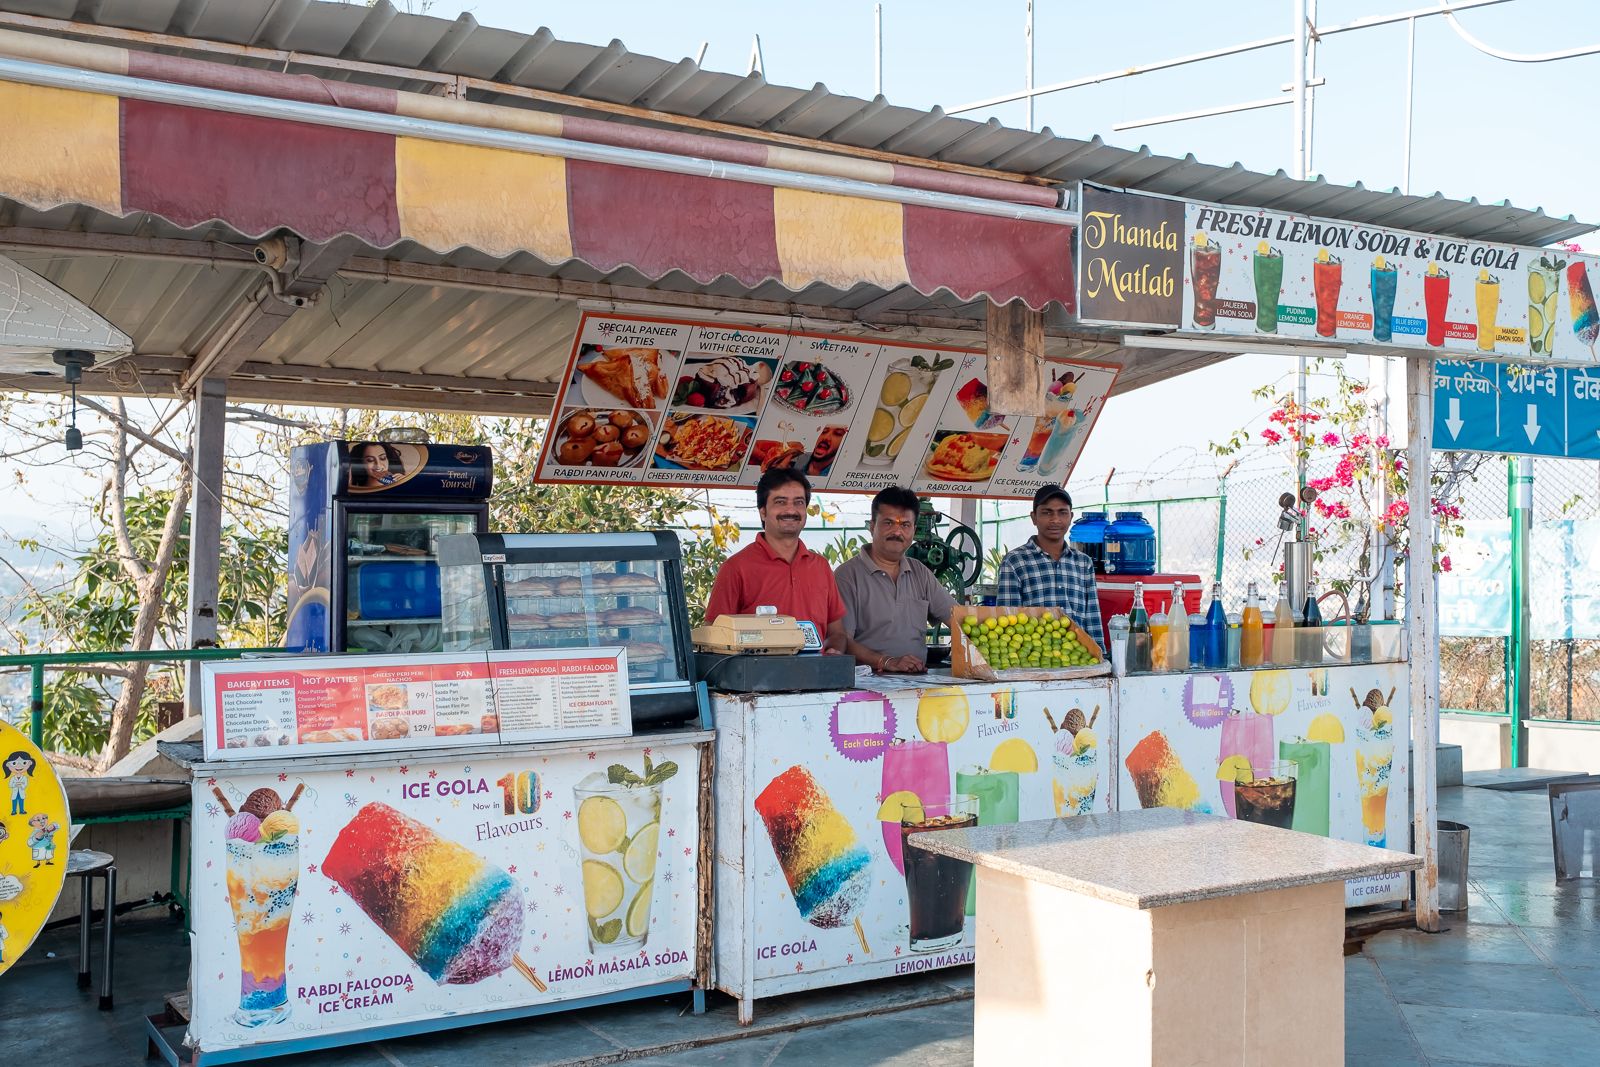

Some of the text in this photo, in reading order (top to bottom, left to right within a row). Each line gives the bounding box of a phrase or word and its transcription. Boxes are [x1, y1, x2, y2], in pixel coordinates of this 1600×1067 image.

[1084, 211, 1178, 251] Thanda
[1196, 208, 1519, 270] FRESH LEMON SODA & ICE GOLA
[1087, 258, 1174, 302] Matlab
[1222, 301, 1248, 310] JALJEERA
[1286, 307, 1307, 315] PUDINA
[1216, 308, 1253, 319] LEMON SODA
[1278, 314, 1314, 324] LEMON SODA
[1343, 312, 1365, 321] ORANGE
[597, 322, 678, 337] SPECIAL PANEER
[1337, 320, 1370, 329] LEMON SODA
[1393, 325, 1424, 334] LEMON SODA
[1452, 323, 1468, 331] GUAVA
[699, 330, 780, 346] HOT CHOCO LAVA
[1445, 330, 1475, 339] LEMON SODA
[614, 335, 655, 346] PATTIES
[699, 341, 775, 356] WITH ICE CREAM
[809, 341, 859, 354] SWEET PAN
[1454, 371, 1490, 395] एरिया
[447, 470, 468, 479] Treat
[553, 468, 632, 479] RABDI PANI PURI
[647, 471, 737, 482] CHEESY PERI PERI NACHOS
[845, 471, 900, 480] FRESH LEMON
[440, 476, 477, 492] Yourself
[840, 480, 863, 488] SODA
[926, 483, 972, 492] RABDI GOLA
[1006, 478, 1031, 487] CREAM
[518, 667, 540, 675] LEMON
[540, 666, 557, 674] SODA
[582, 663, 615, 671] FALOODA
[456, 670, 473, 678] PAN
[227, 678, 290, 689] BAKERY ITEMS
[302, 675, 358, 685] HOT PATTIES
[413, 724, 434, 732] 129/-
[977, 721, 1020, 739] Flavours
[843, 738, 885, 749] Each Glass
[402, 778, 490, 800] ICE GOLA
[472, 770, 542, 816] Now in 10
[475, 816, 543, 842] Flavours
[1352, 884, 1391, 897] ICE CREAM
[757, 939, 817, 960] ICE GOLA
[548, 950, 688, 983] LEMON MASALA SODA
[895, 957, 933, 974] LEMON
[297, 973, 413, 999] RABDI FALOODA
[318, 992, 394, 1014] ICE CREAM
